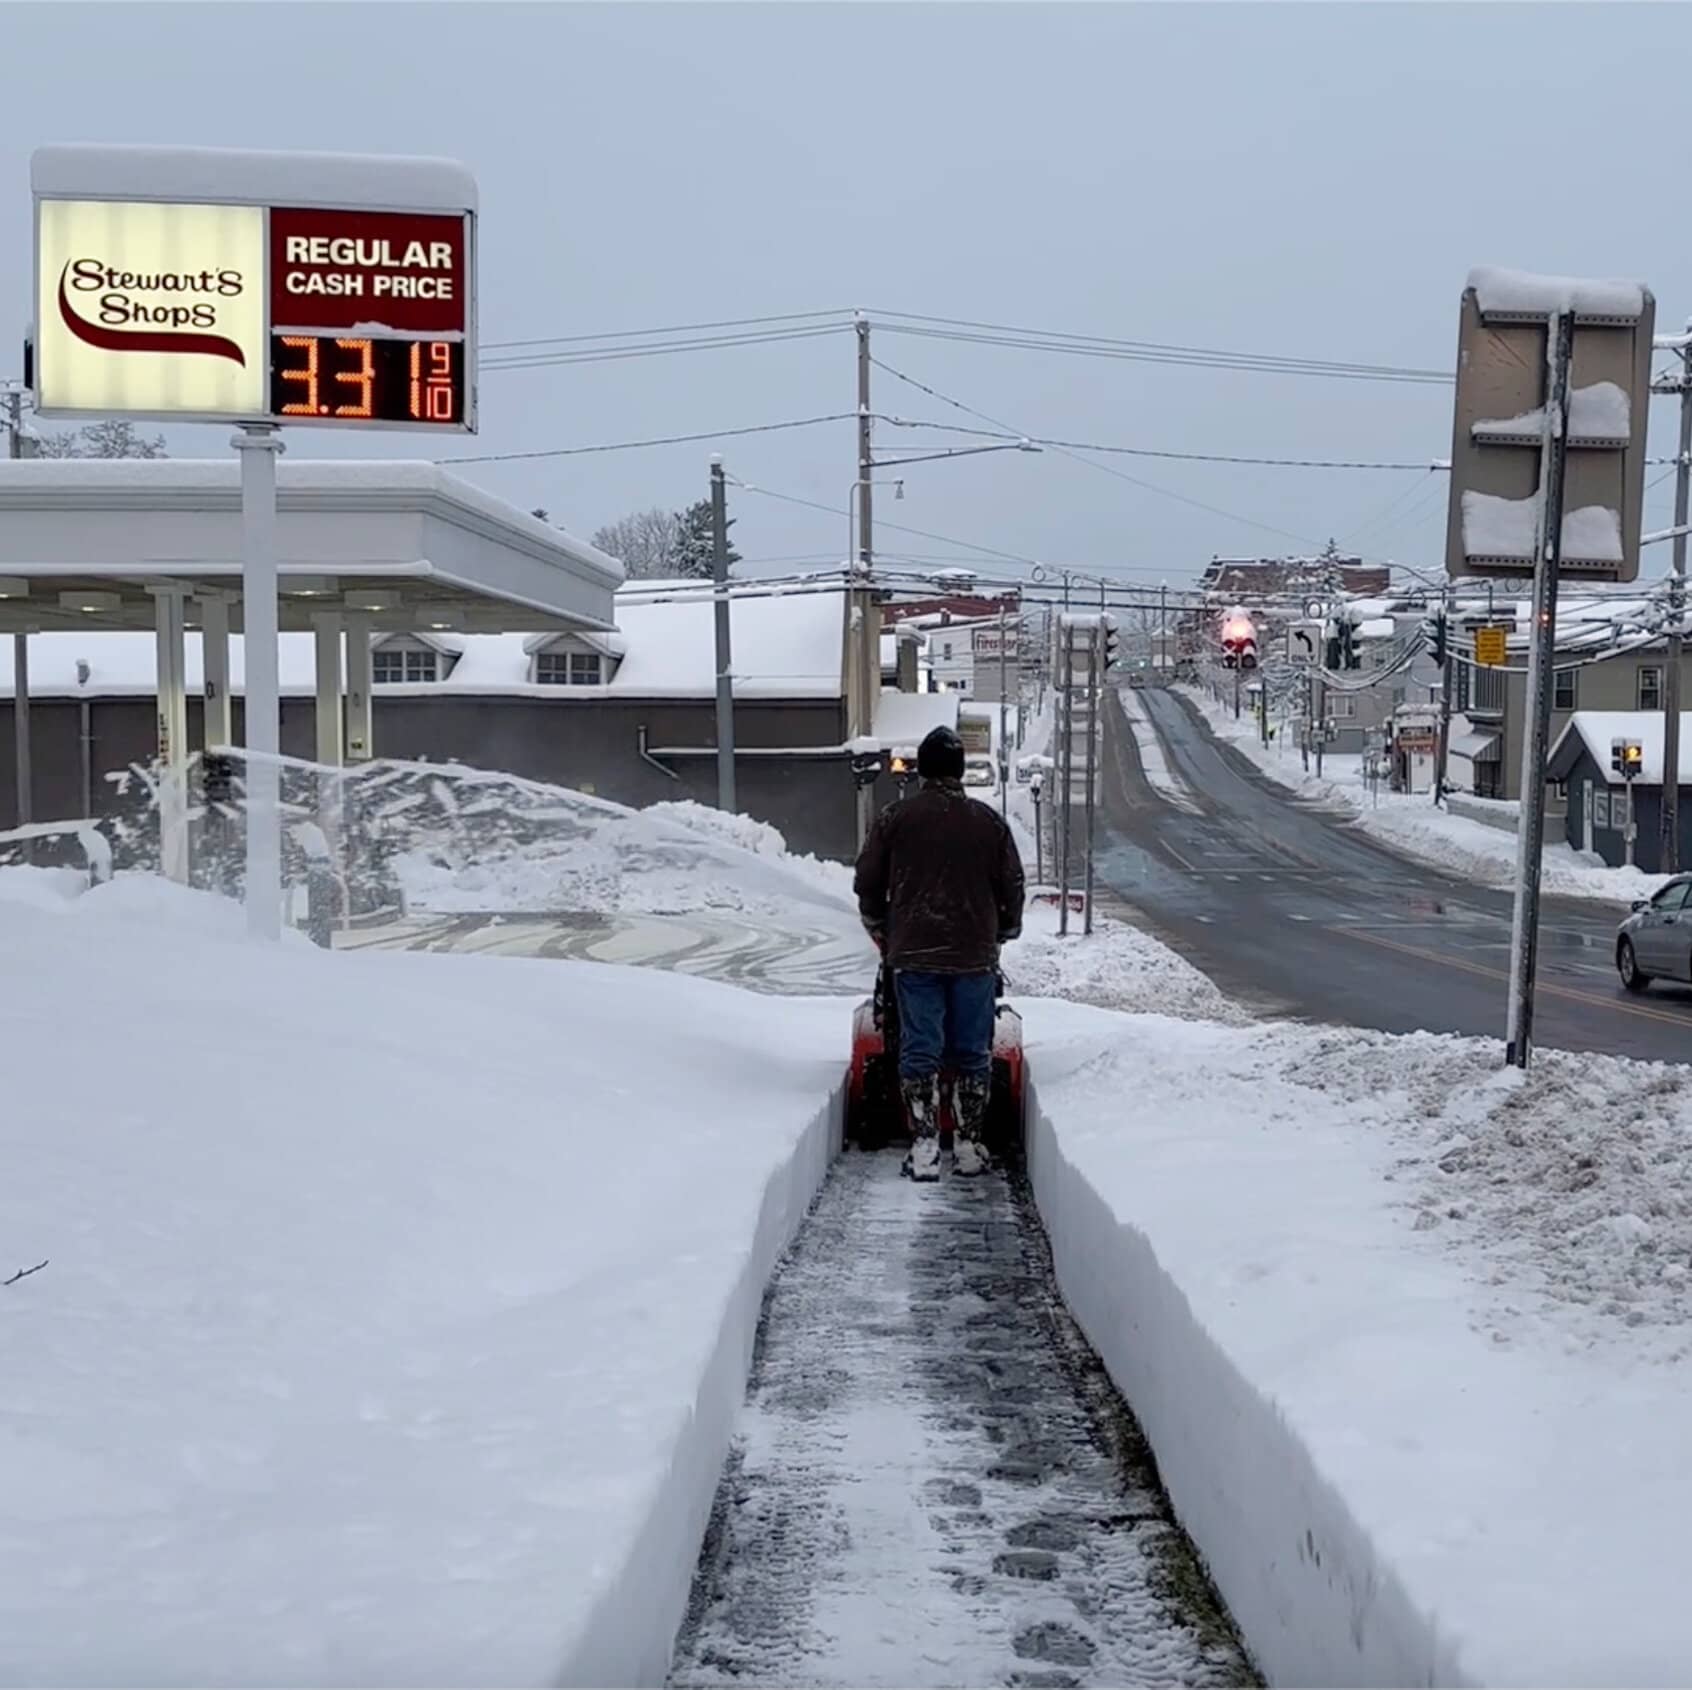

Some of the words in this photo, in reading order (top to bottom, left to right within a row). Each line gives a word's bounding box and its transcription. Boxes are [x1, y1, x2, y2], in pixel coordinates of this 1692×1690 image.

[286, 236, 453, 269] REGULAR
[71, 258, 243, 297] Stewart's
[286, 271, 364, 296] CASH
[373, 274, 453, 300] PRICE
[99, 293, 216, 328] Shops
[281, 336, 420, 418] 3.31
